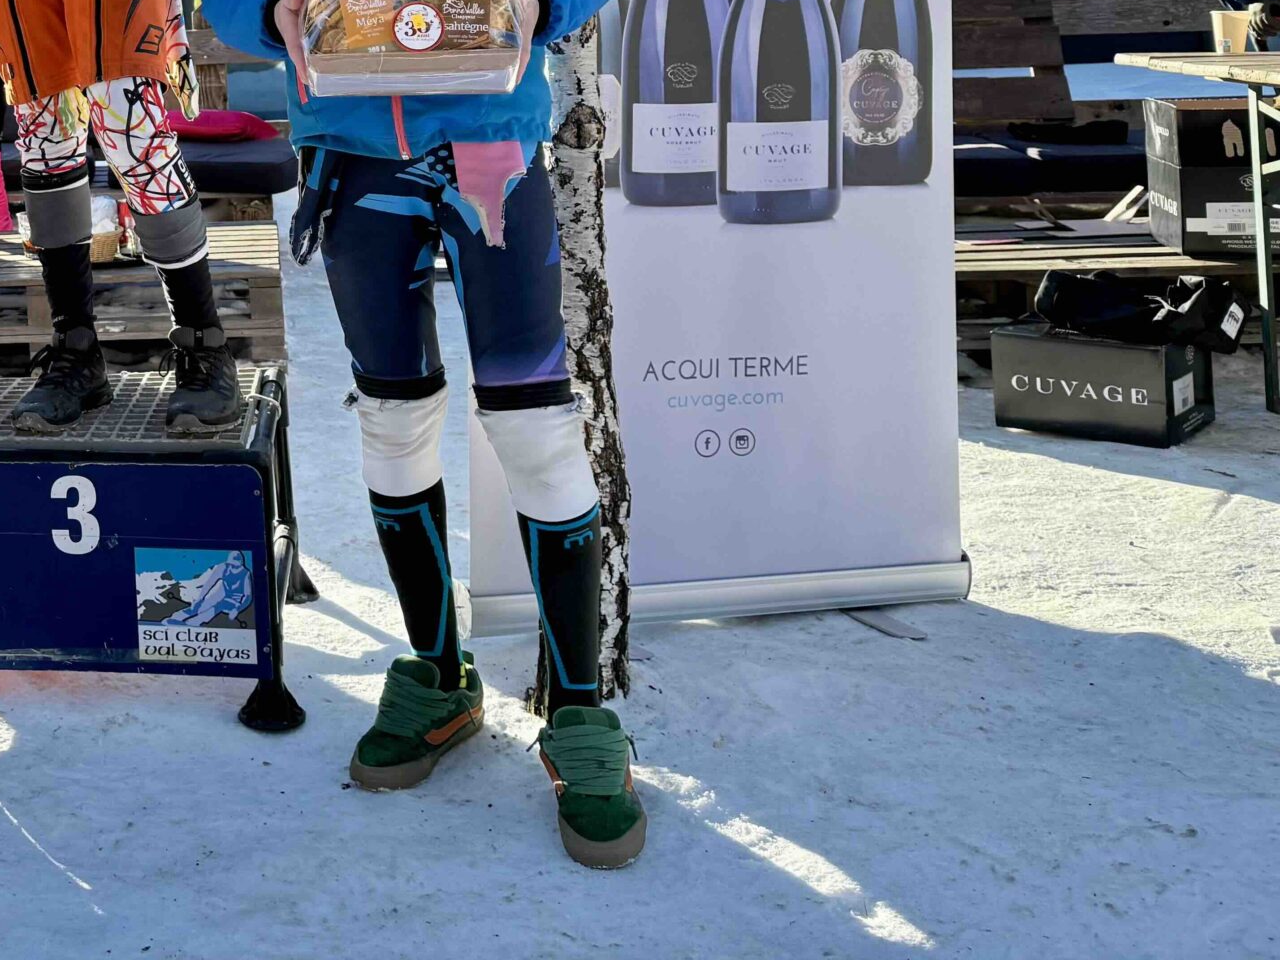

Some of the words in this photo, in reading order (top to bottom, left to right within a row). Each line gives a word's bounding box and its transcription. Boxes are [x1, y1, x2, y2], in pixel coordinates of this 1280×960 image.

[854, 100, 898, 109] CUVAGE
[649, 126, 717, 138] CUVAGE
[743, 144, 812, 156] CUVAGE
[1149, 190, 1178, 217] CUVAGE
[642, 358, 720, 382] ACQUI
[728, 355, 809, 378] TERME
[1011, 374, 1148, 406] CUVAGE
[667, 391, 784, 412] cuvage.com
[50, 475, 100, 555] 3
[143, 628, 169, 641] sci
[144, 643, 178, 658] val
